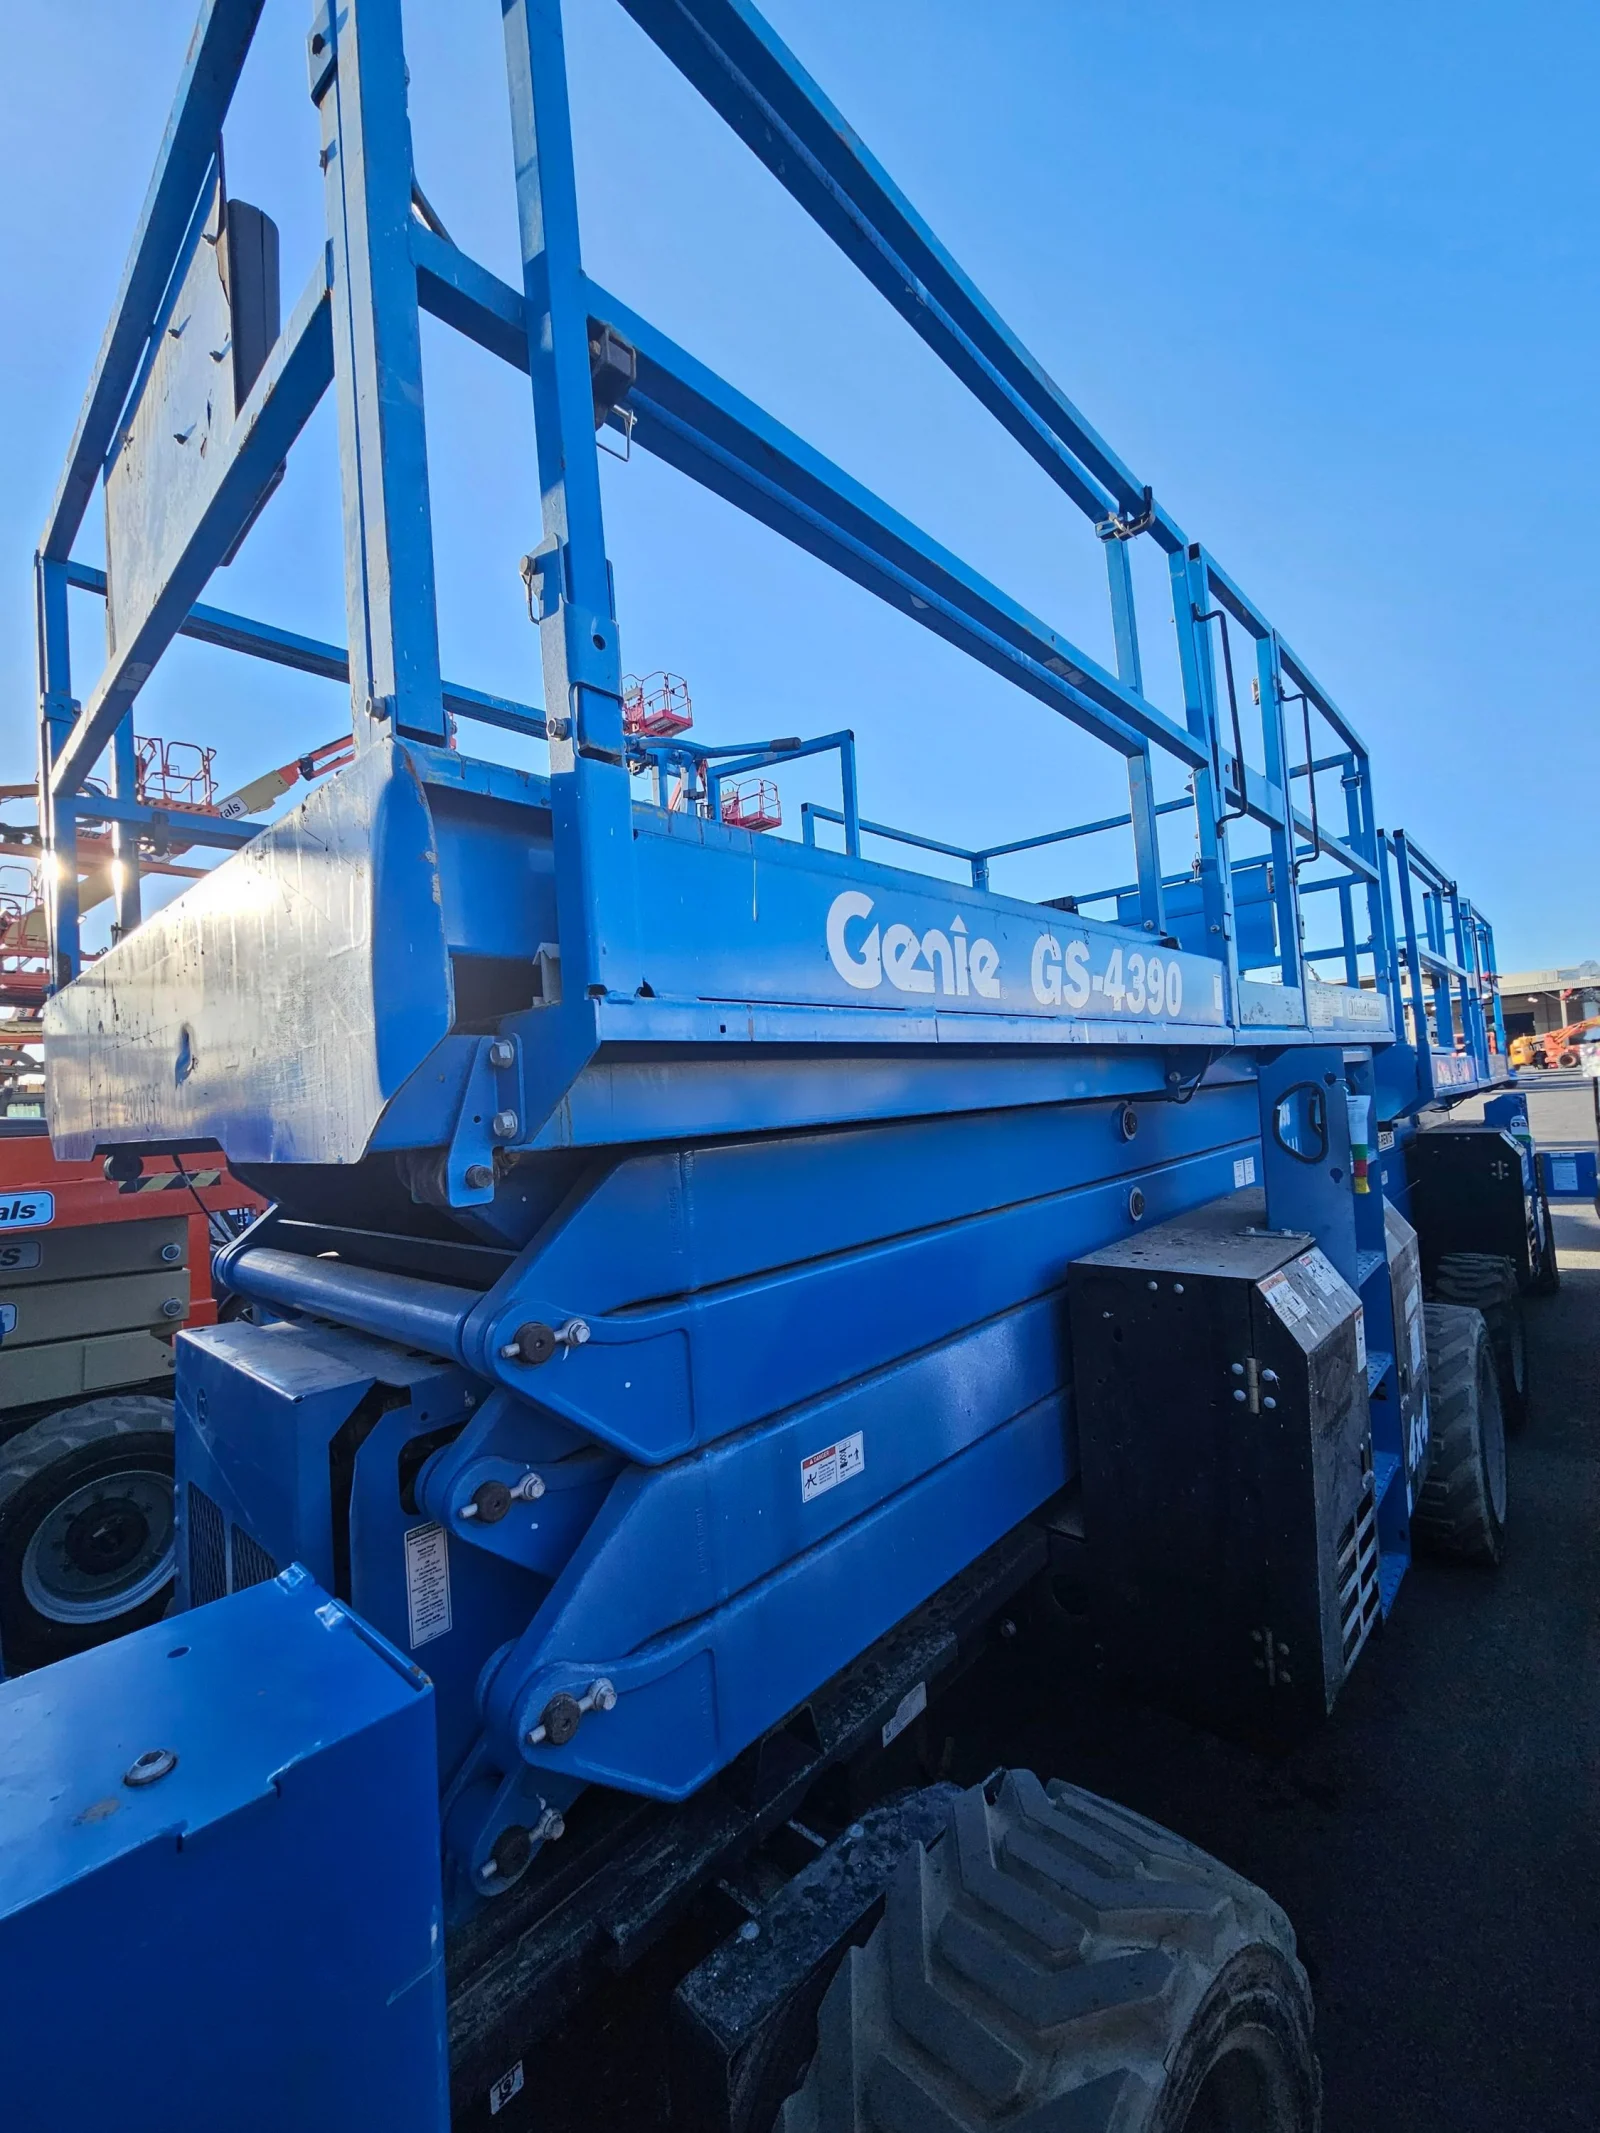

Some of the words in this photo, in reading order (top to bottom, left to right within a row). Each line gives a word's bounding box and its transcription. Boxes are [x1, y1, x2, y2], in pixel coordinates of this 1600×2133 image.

[826, 890, 1000, 999] Genie
[1030, 933, 1183, 1017] GS-4390
[813, 1450, 830, 1463] DANGER
